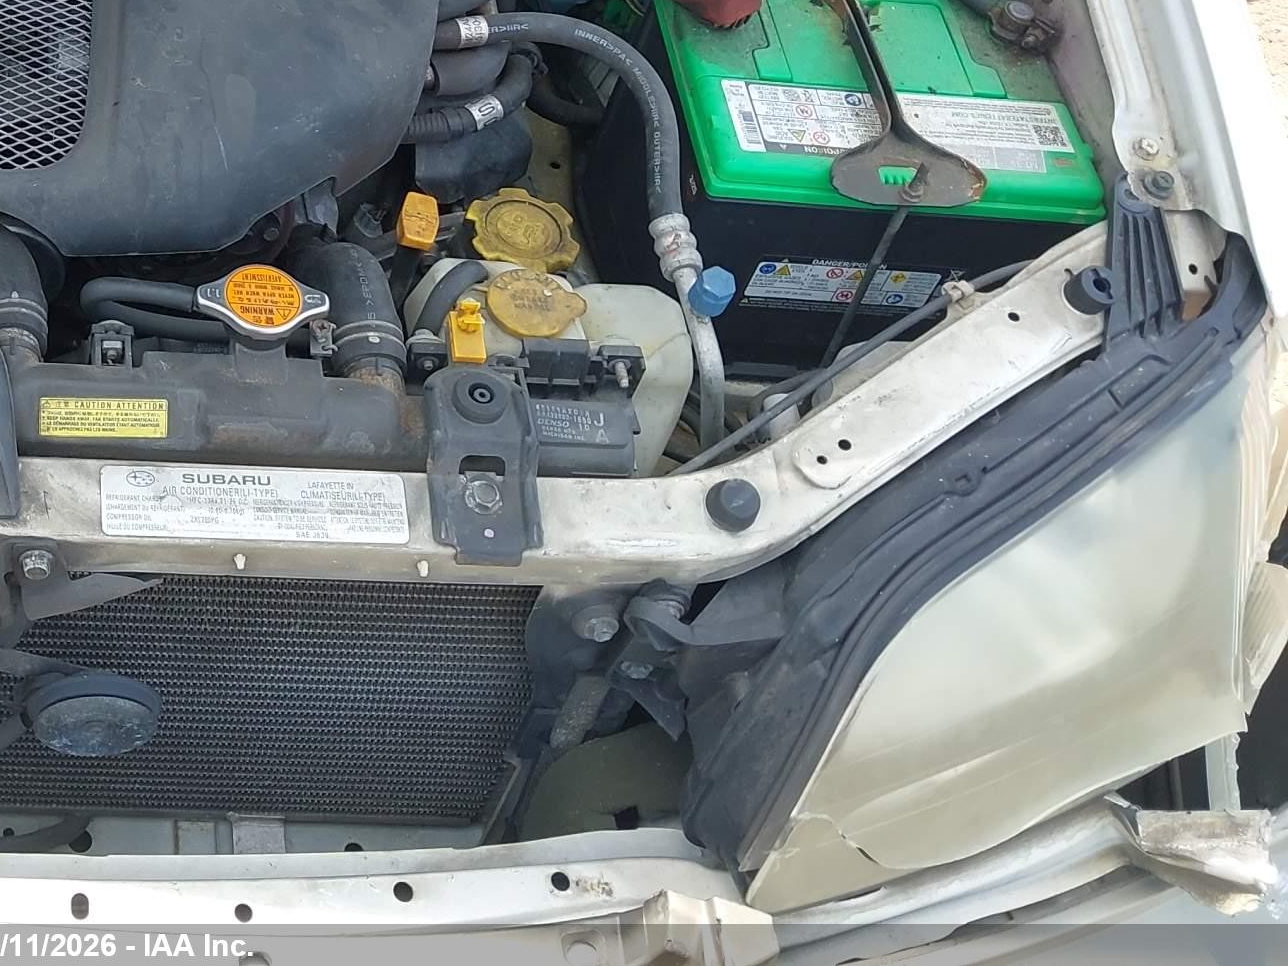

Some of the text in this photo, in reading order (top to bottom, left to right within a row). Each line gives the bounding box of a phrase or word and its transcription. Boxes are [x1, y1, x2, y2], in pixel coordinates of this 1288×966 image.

[812, 259, 888, 271] DANGER/POIN
[240, 305, 275, 316] WARNING
[74, 401, 164, 410] CAUTION ATTENTION
[537, 417, 570, 428] DENSO
[593, 412, 605, 427] J
[182, 473, 271, 486] SUBARU
[162, 485, 177, 496] AIR
